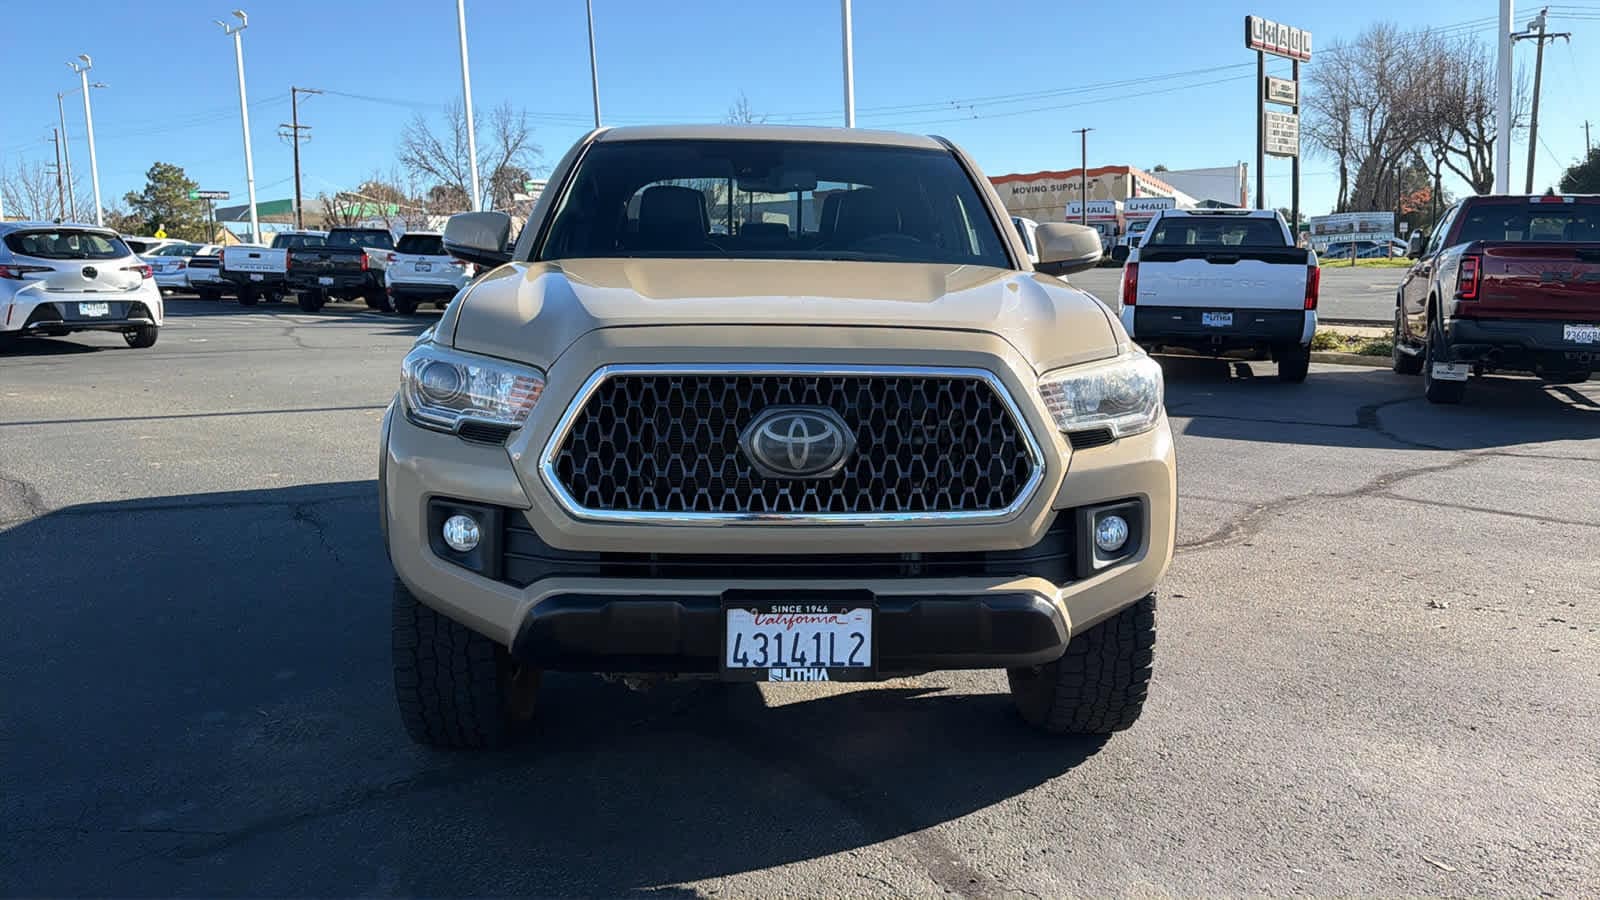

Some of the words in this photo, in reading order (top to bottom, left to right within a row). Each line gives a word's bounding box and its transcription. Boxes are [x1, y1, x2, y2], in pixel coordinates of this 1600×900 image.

[1011, 184, 1048, 195] MOVING
[1050, 182, 1094, 192] SUPPLIS
[1128, 202, 1170, 211] U-HAUL
[771, 605, 802, 613] SINCE
[806, 605, 829, 613] 1946
[754, 613, 848, 631] California
[732, 632, 865, 668] 43141L2
[782, 668, 829, 682] LITHIA
